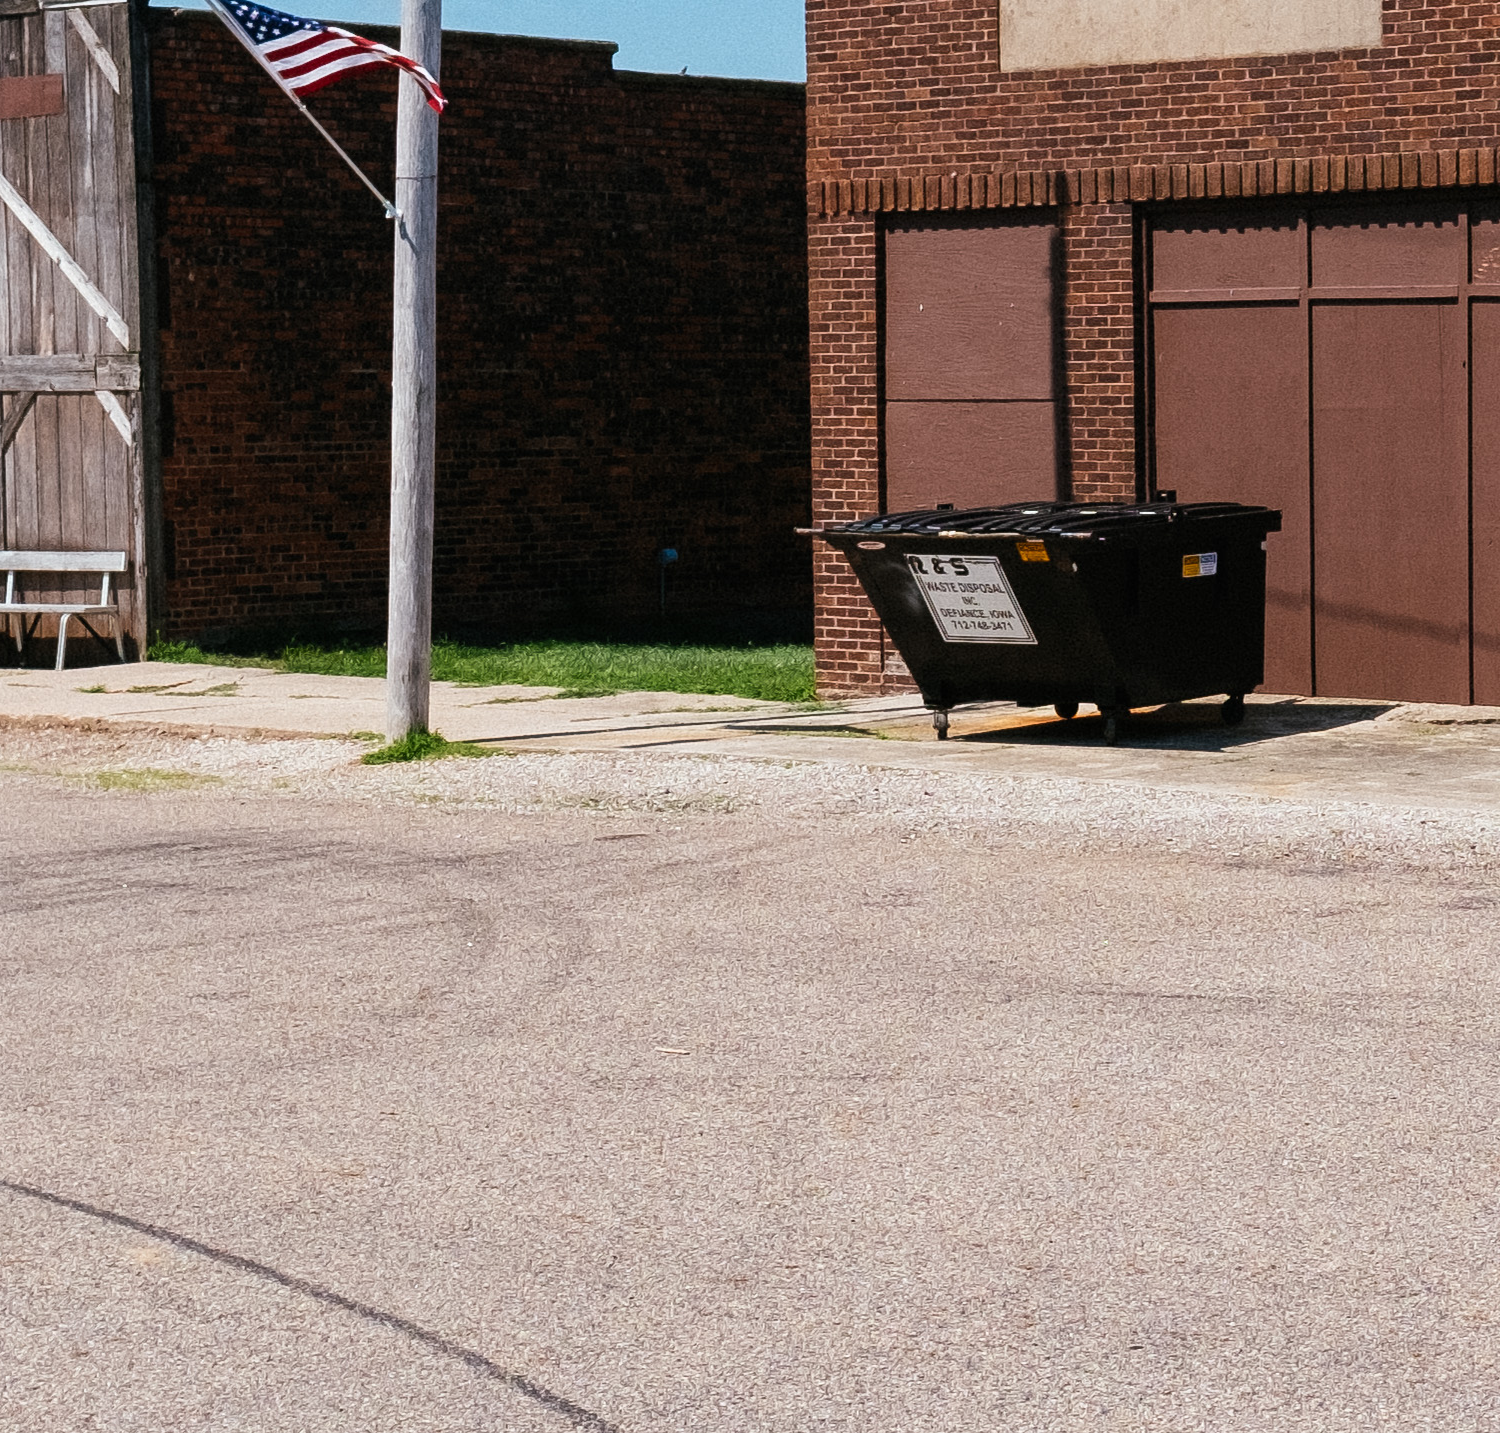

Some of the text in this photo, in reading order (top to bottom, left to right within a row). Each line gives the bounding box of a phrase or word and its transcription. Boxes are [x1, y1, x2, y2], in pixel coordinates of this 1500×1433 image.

[908, 555, 970, 576] R & S
[925, 581, 1006, 594] WASTE DISPOSAL
[988, 609, 1015, 619] IOWA
